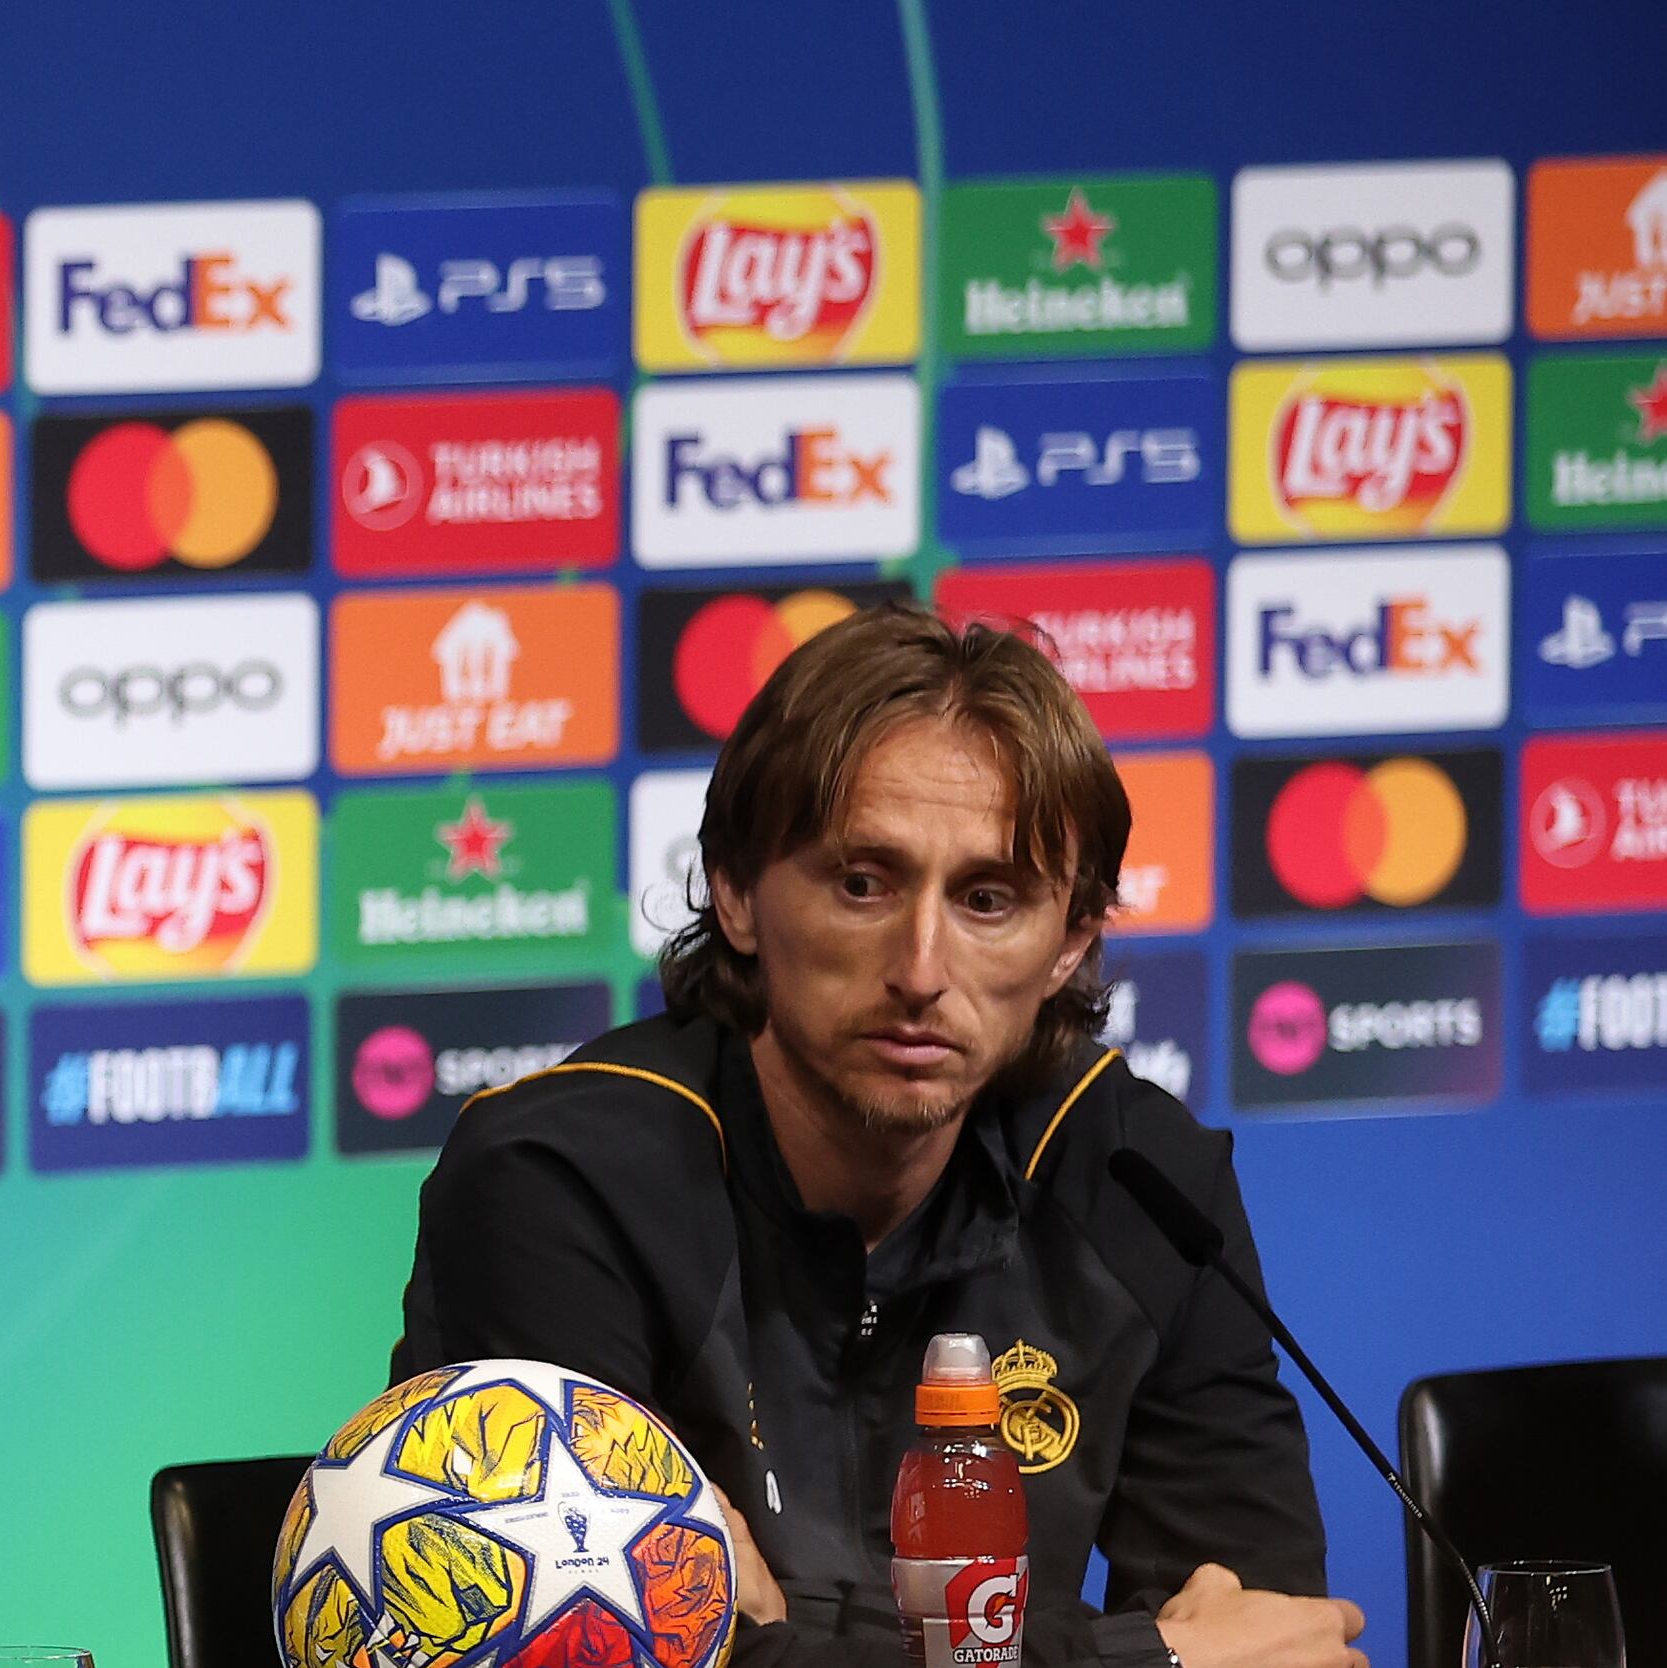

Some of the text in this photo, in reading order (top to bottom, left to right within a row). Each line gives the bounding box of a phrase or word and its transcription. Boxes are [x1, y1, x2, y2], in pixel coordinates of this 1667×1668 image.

[438, 255, 607, 315] PS5
[691, 220, 866, 341] Lay's
[1265, 223, 1481, 293] oppo
[56, 250, 294, 336] FedEx
[965, 281, 1189, 334] Heineken
[428, 437, 601, 477] TURKISH
[665, 423, 894, 510] FedEx
[1038, 427, 1202, 485] PS5
[1284, 387, 1460, 513] Lay's
[428, 475, 602, 523] AIRLINES
[1259, 594, 1481, 682] FedEx
[58, 658, 284, 725] oppo
[377, 702, 573, 758] JUST EAT
[79, 828, 262, 952] Lay's
[357, 881, 591, 945] Heineken
[1328, 1001, 1482, 1051] SPORTS
[41, 1043, 299, 1126] #FOOTBALL
[968, 1574, 1018, 1643] G
